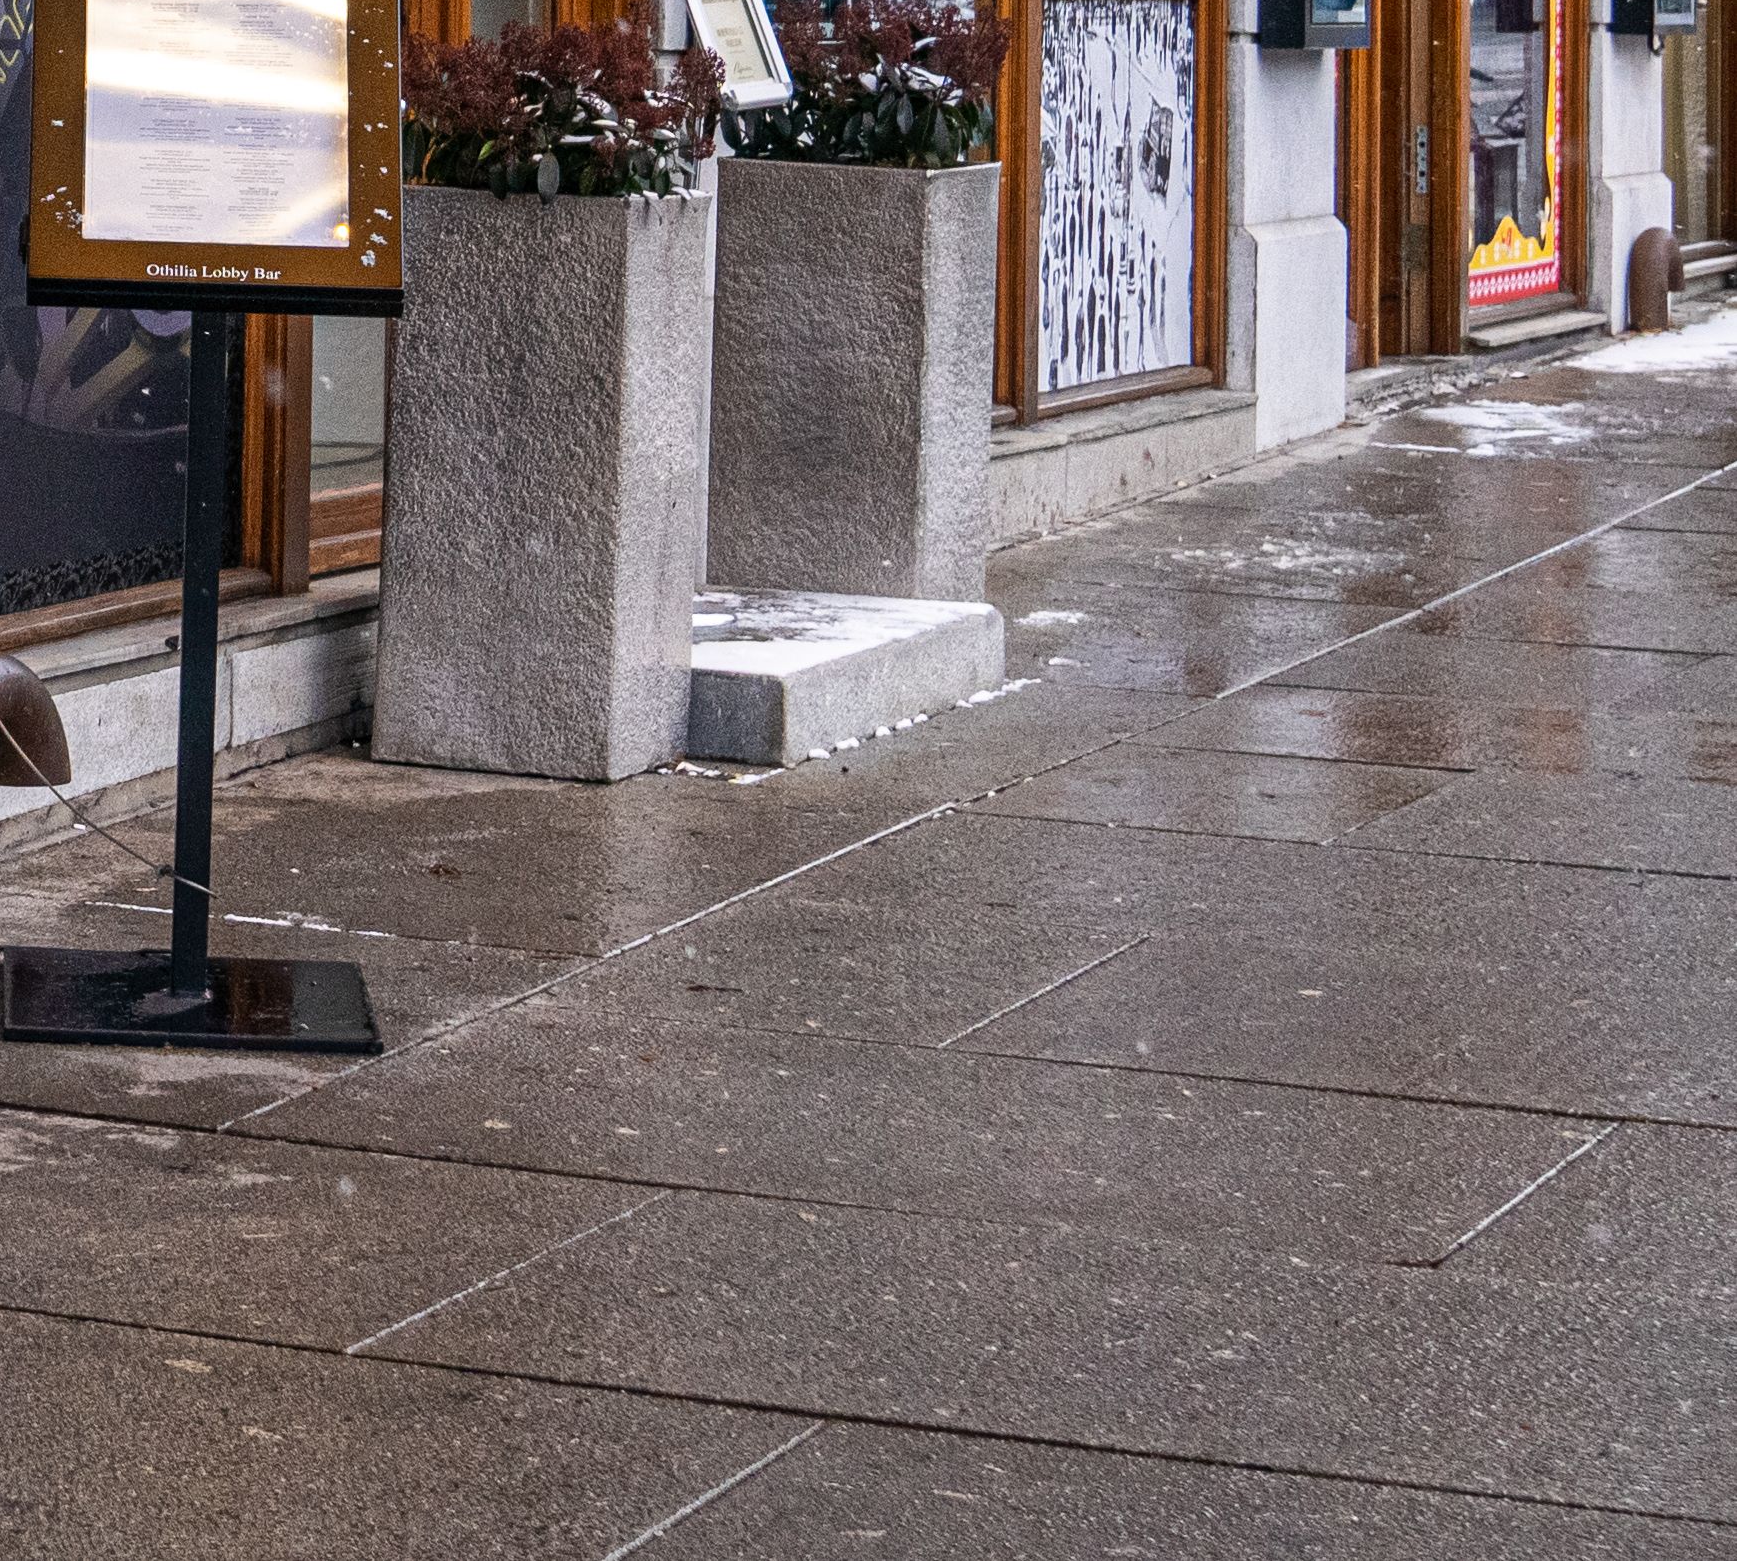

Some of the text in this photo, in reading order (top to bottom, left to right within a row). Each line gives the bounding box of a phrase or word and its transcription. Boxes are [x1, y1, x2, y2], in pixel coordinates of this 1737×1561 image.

[146, 262, 281, 282] Othilia Lobby Bar
